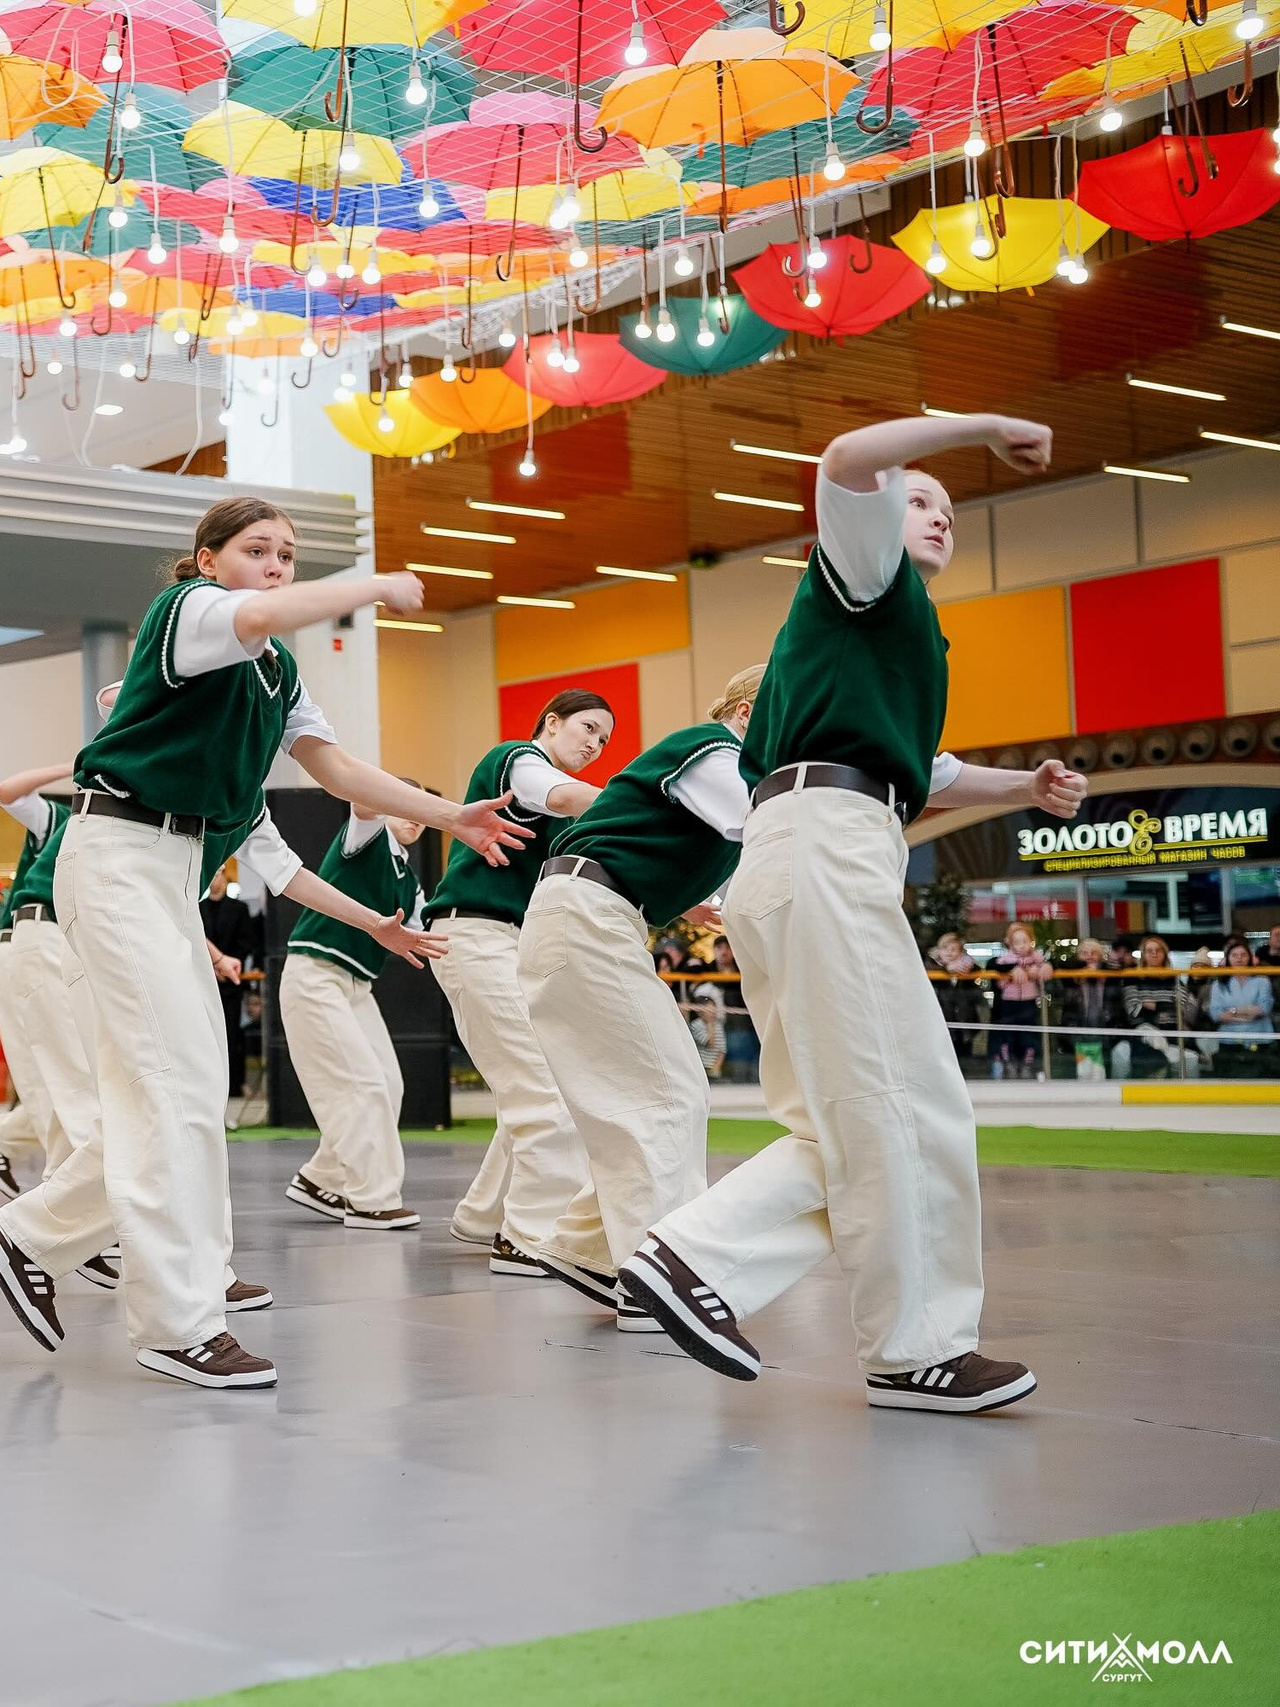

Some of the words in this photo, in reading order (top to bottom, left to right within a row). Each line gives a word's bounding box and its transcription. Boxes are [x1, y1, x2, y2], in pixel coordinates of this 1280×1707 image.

[1017, 821, 1134, 855] ЗОЛОТО
[1163, 808, 1268, 843] ВРЕМЯ
[1159, 848, 1208, 864] МАГАЗИН
[1211, 846, 1246, 859] ЧАСОВ
